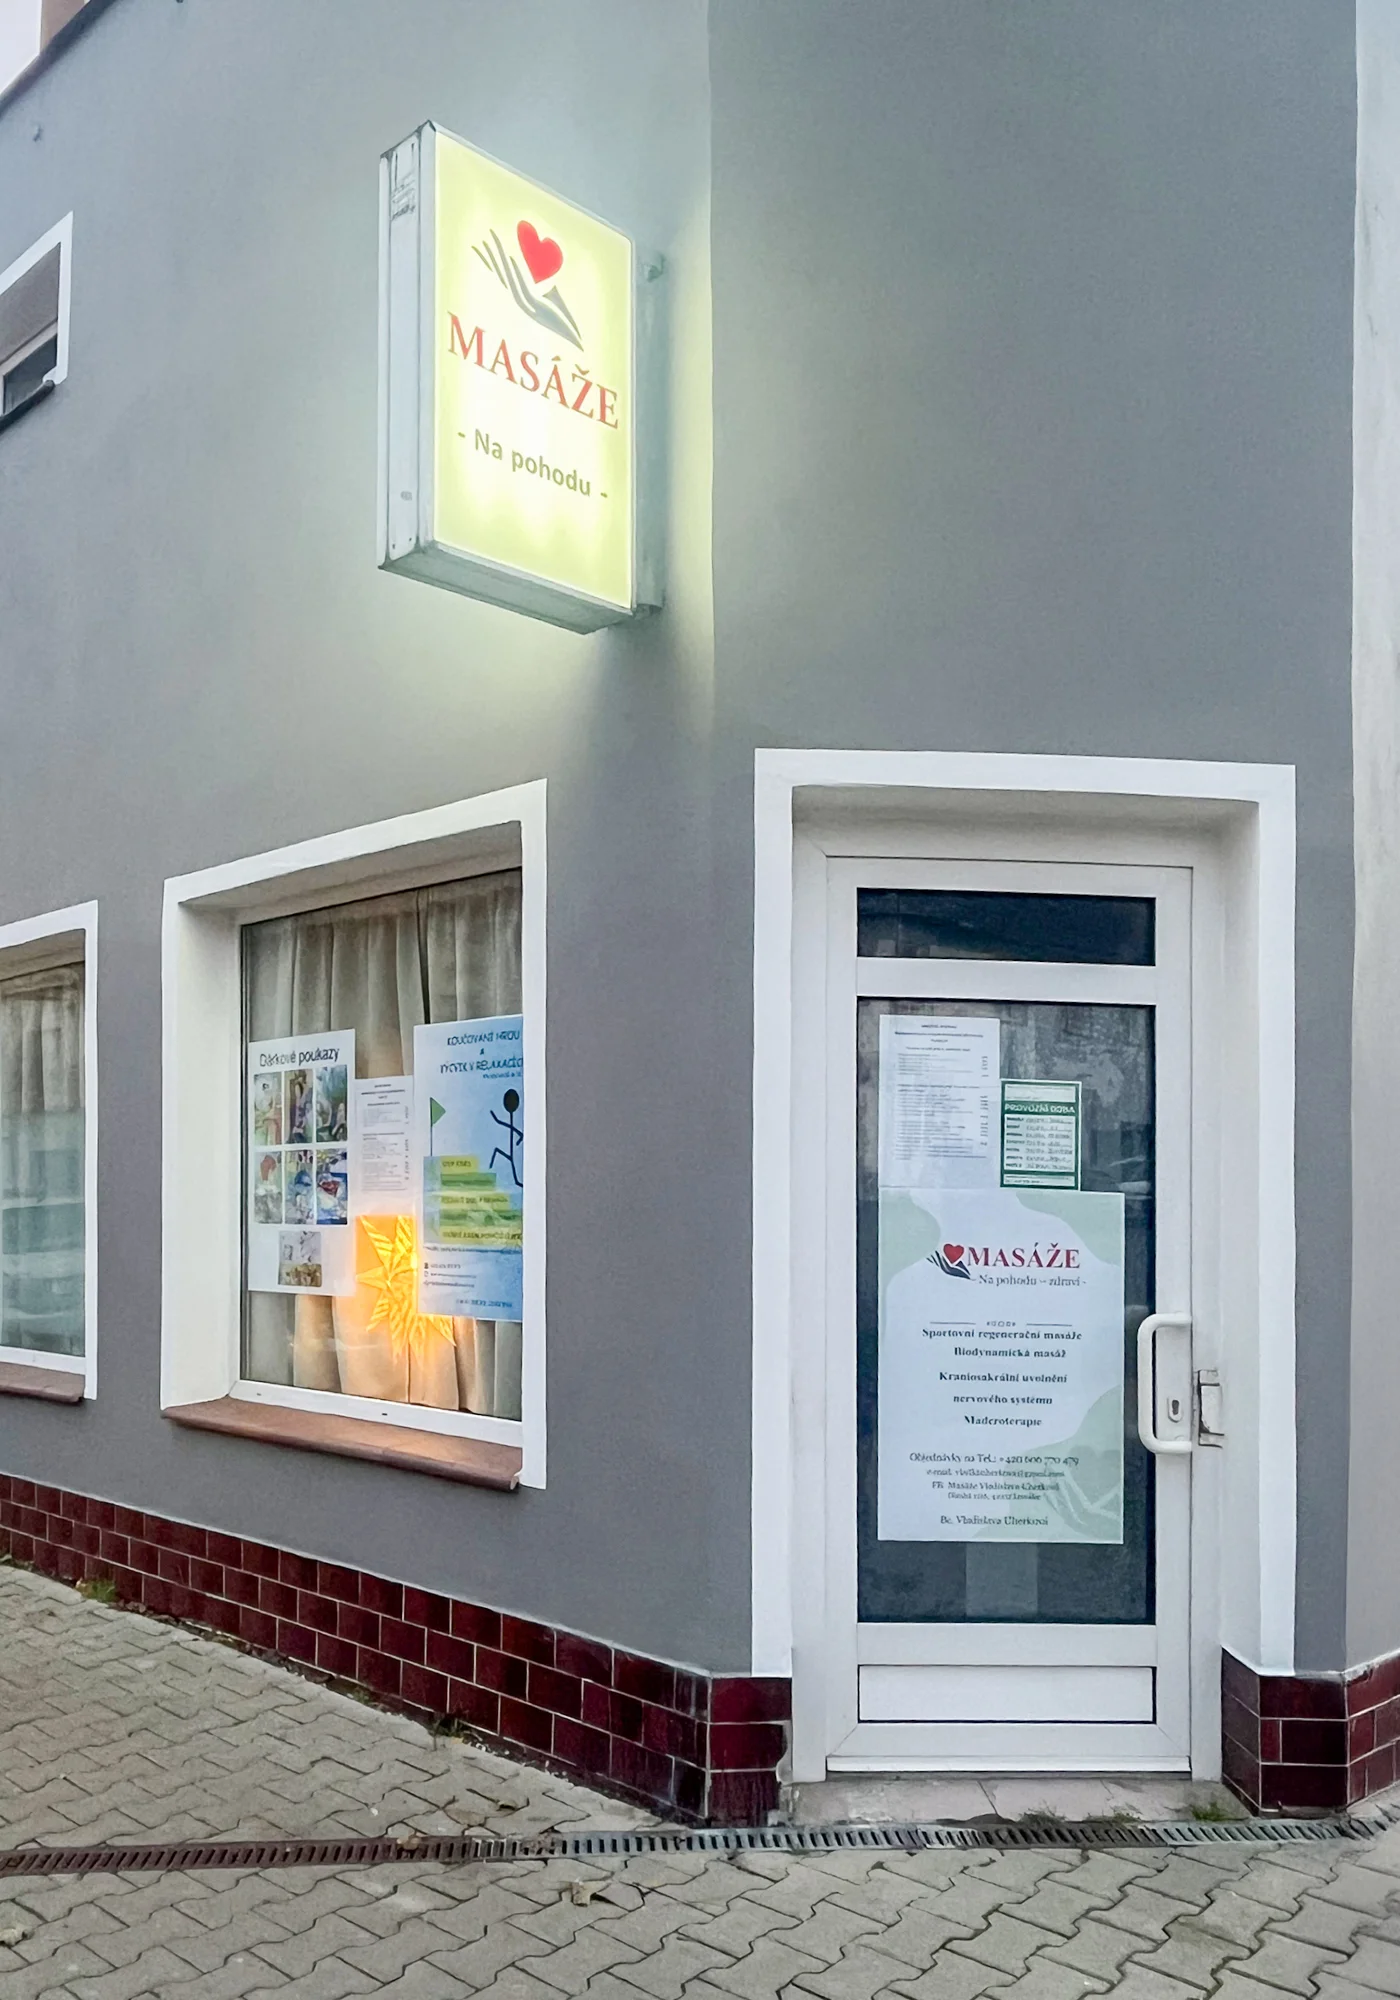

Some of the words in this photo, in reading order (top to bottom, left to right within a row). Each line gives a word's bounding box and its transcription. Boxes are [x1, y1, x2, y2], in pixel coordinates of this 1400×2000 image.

[447, 310, 618, 430] MASÁŽE
[475, 428, 503, 460] Na
[511, 450, 591, 497] pohodu
[967, 1241, 1081, 1269] MASÁŽE
[979, 1274, 994, 1285] Na
[996, 1274, 1037, 1286] pohodu
[1049, 1275, 1081, 1287] zdraví
[922, 1328, 975, 1340] Sportovní
[978, 1330, 1041, 1340] regenerační
[1043, 1331, 1083, 1340] masáže
[954, 1347, 1030, 1358] Biodynamická
[1033, 1349, 1067, 1358] masáž
[939, 1371, 1020, 1383] Kraniosakrální
[1022, 1373, 1068, 1384] uvolnění
[953, 1394, 1008, 1404] nervového
[1010, 1396, 1053, 1406] systému
[964, 1415, 1042, 1428] Maderoterapie
